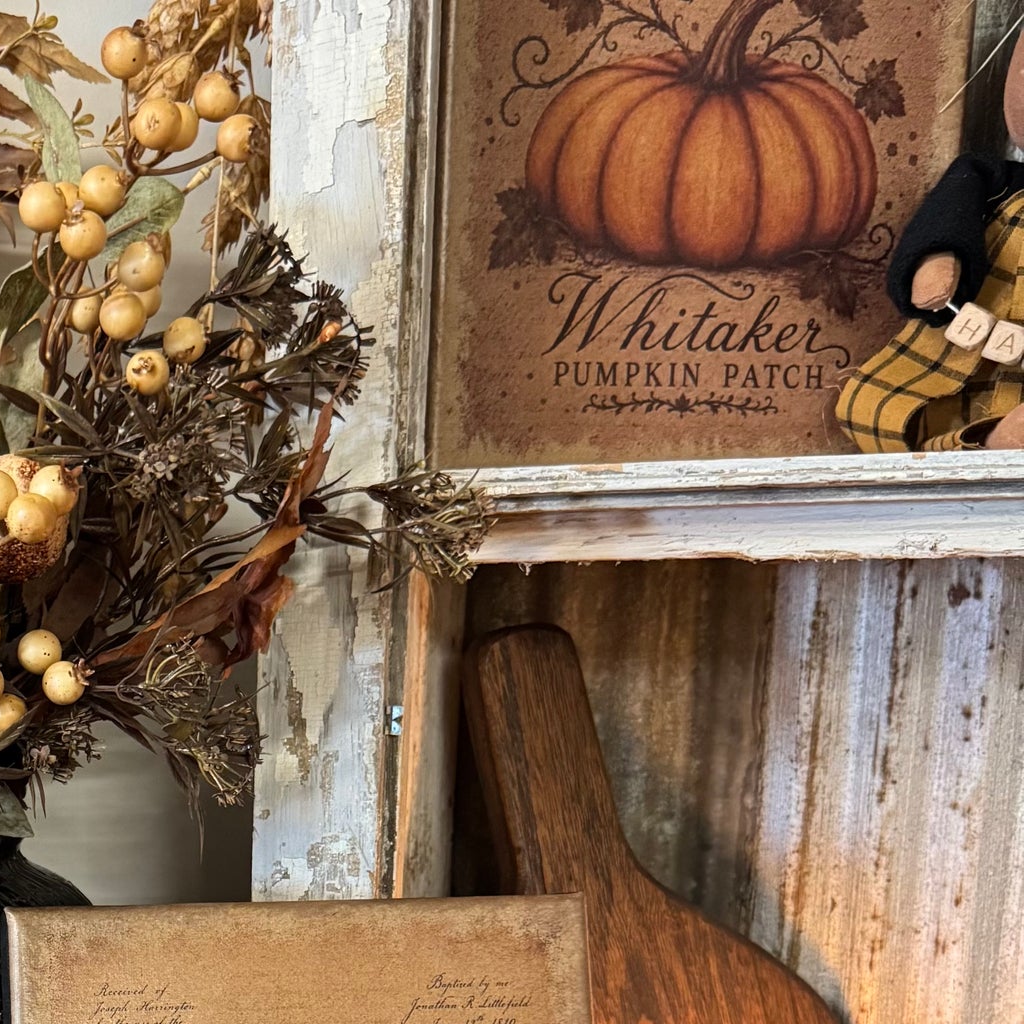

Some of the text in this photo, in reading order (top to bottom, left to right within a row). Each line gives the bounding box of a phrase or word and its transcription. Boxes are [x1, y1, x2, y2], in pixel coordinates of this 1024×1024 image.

[541, 273, 851, 368] Whitaker
[553, 361, 825, 389] PUMPKIN PATCH
[94, 982, 170, 1001] Received of
[479, 975, 490, 995] by
[89, 999, 195, 1020] Joseph Harrington
[478, 995, 532, 1015] Littlefield
